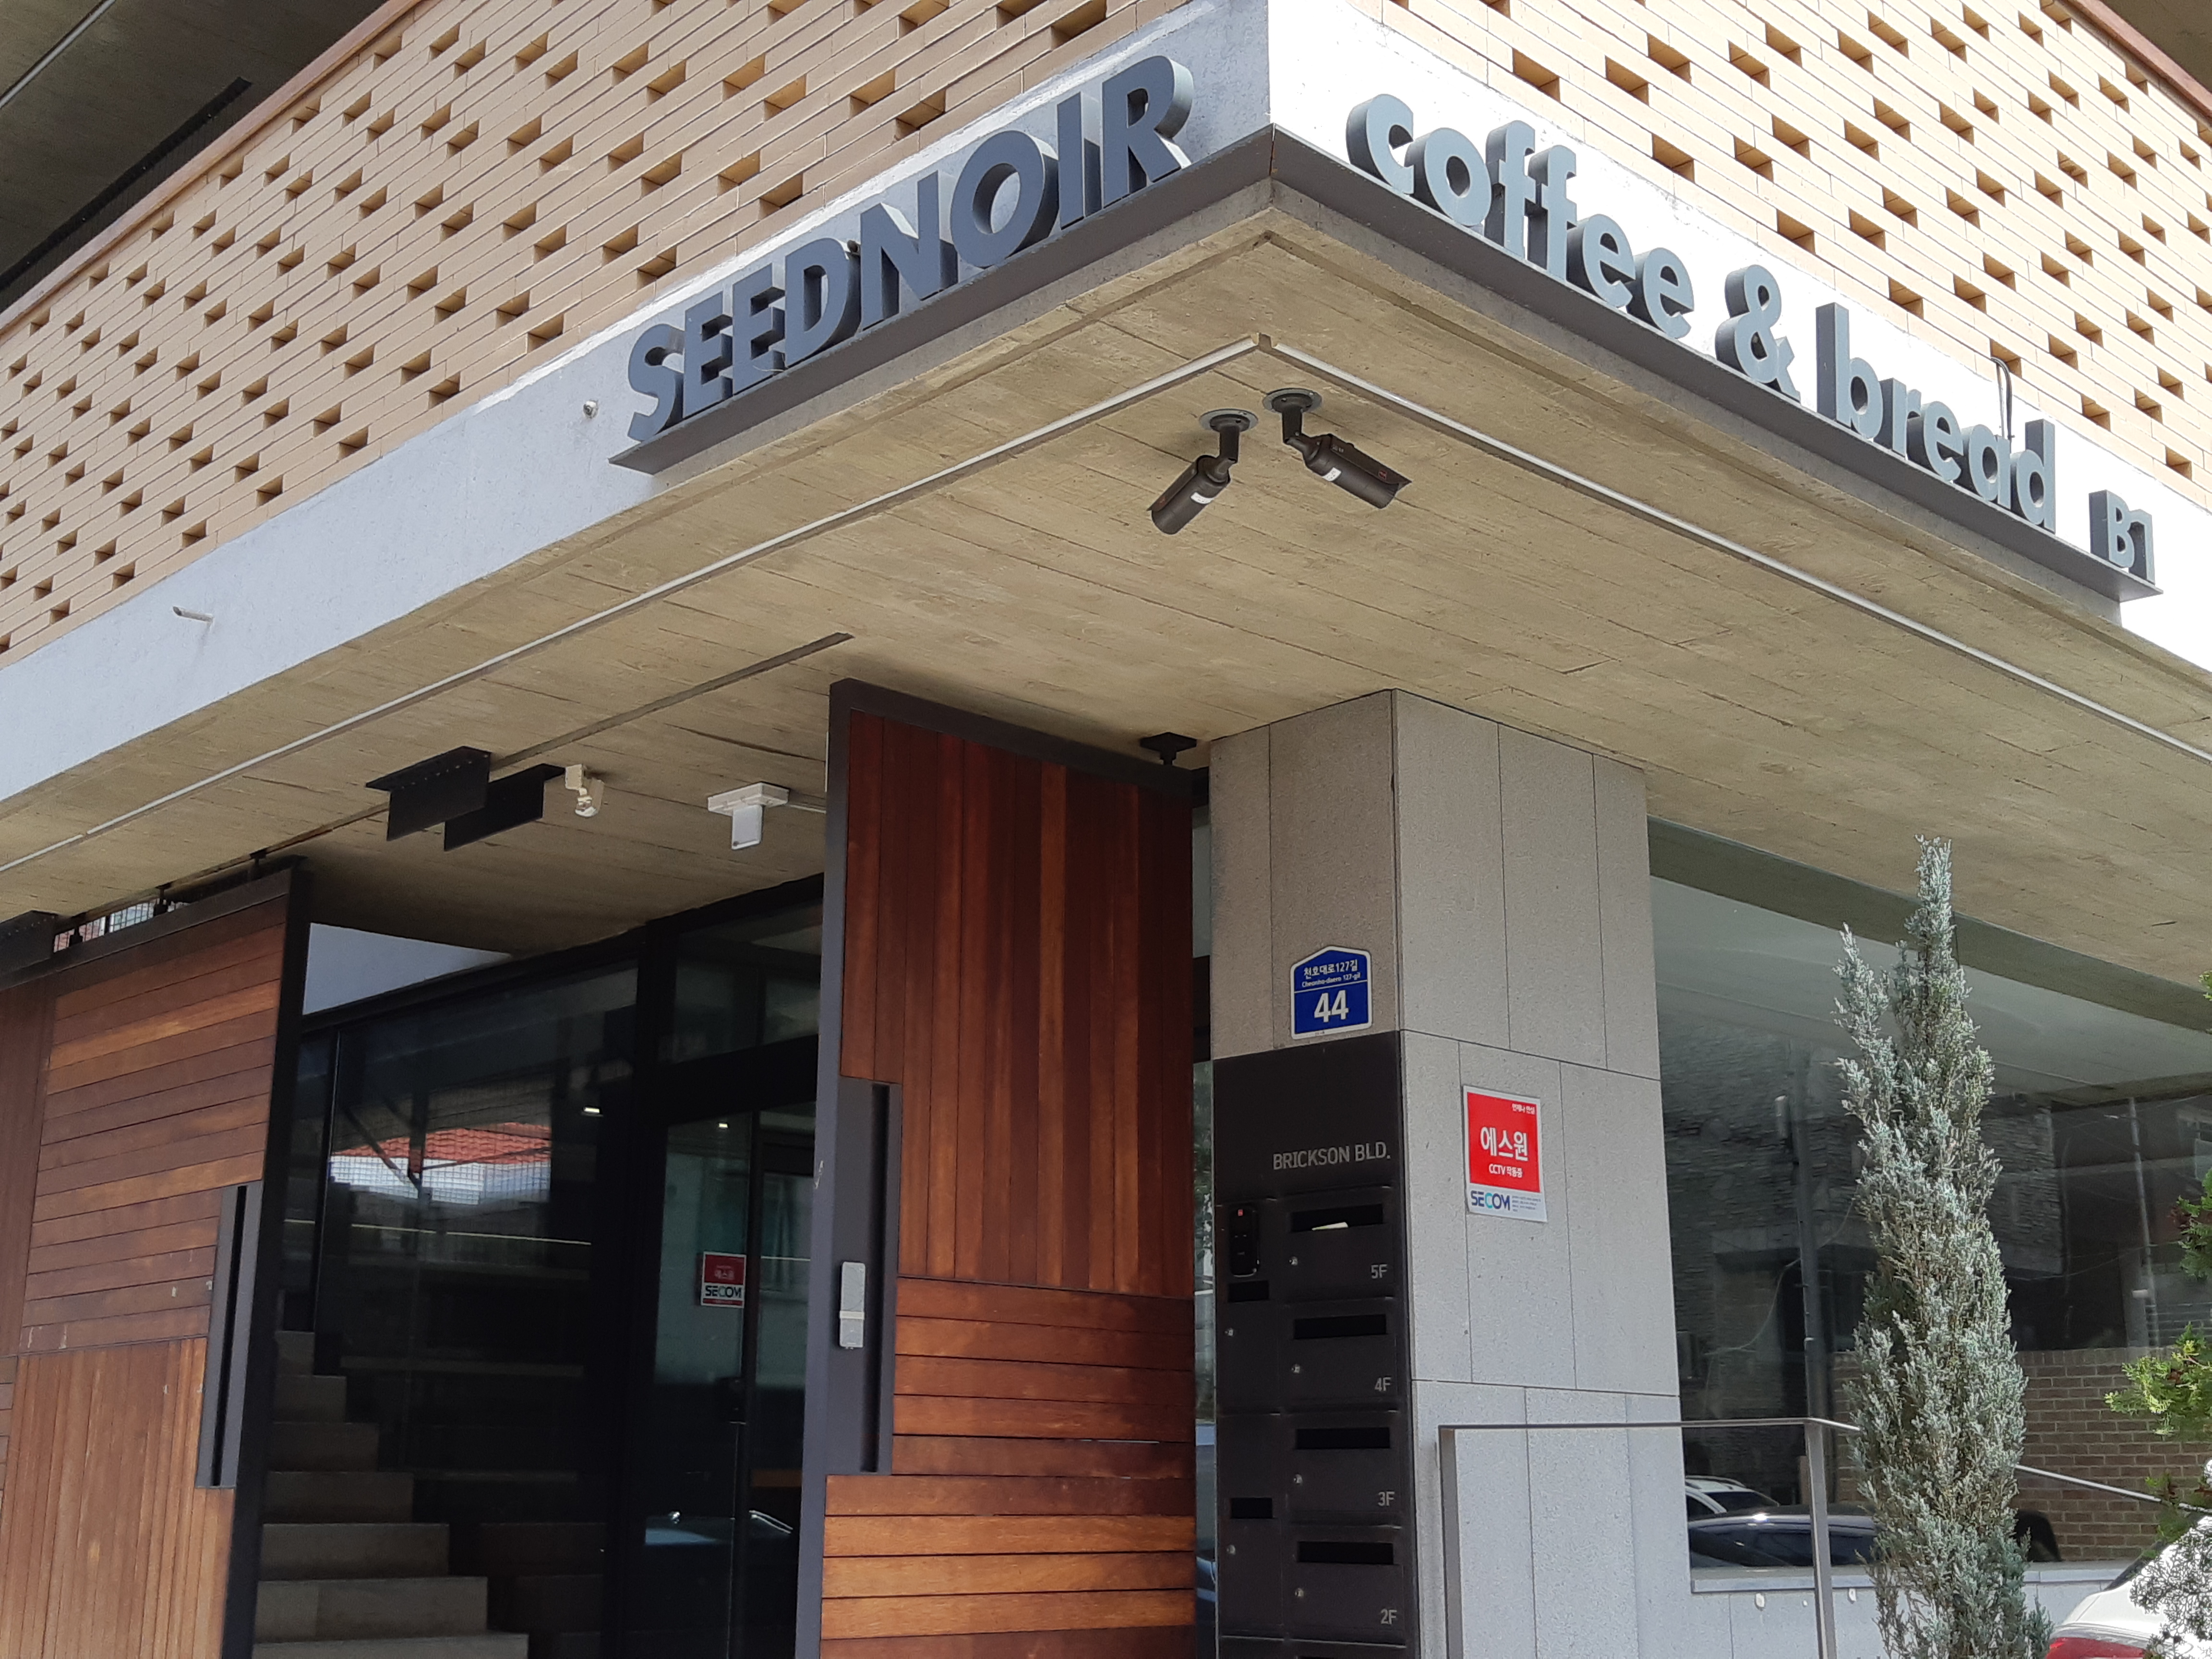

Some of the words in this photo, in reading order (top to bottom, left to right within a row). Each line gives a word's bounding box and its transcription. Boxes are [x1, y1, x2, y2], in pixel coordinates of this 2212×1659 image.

[1346, 93, 1695, 339] coffee
[1715, 264, 1801, 402] &
[1815, 302, 2056, 534] bread
[2089, 489, 2155, 584] B1
[1304, 960, 1358, 979] 천호대로127길
[1314, 990, 1349, 1023] 44
[1480, 1127, 1529, 1162] 에스원
[1273, 1145, 1350, 1170] BRICKSON
[1355, 1142, 1391, 1162] BLD.
[1489, 1163, 1506, 1175] CCTV
[1470, 1190, 1511, 1211] SECOM
[1370, 1264, 1388, 1279] 5F
[705, 1285, 742, 1298] SECOM
[1374, 1377, 1392, 1392] 4F
[1377, 1491, 1395, 1507] 3F
[1380, 1609, 1397, 1625] 2F
